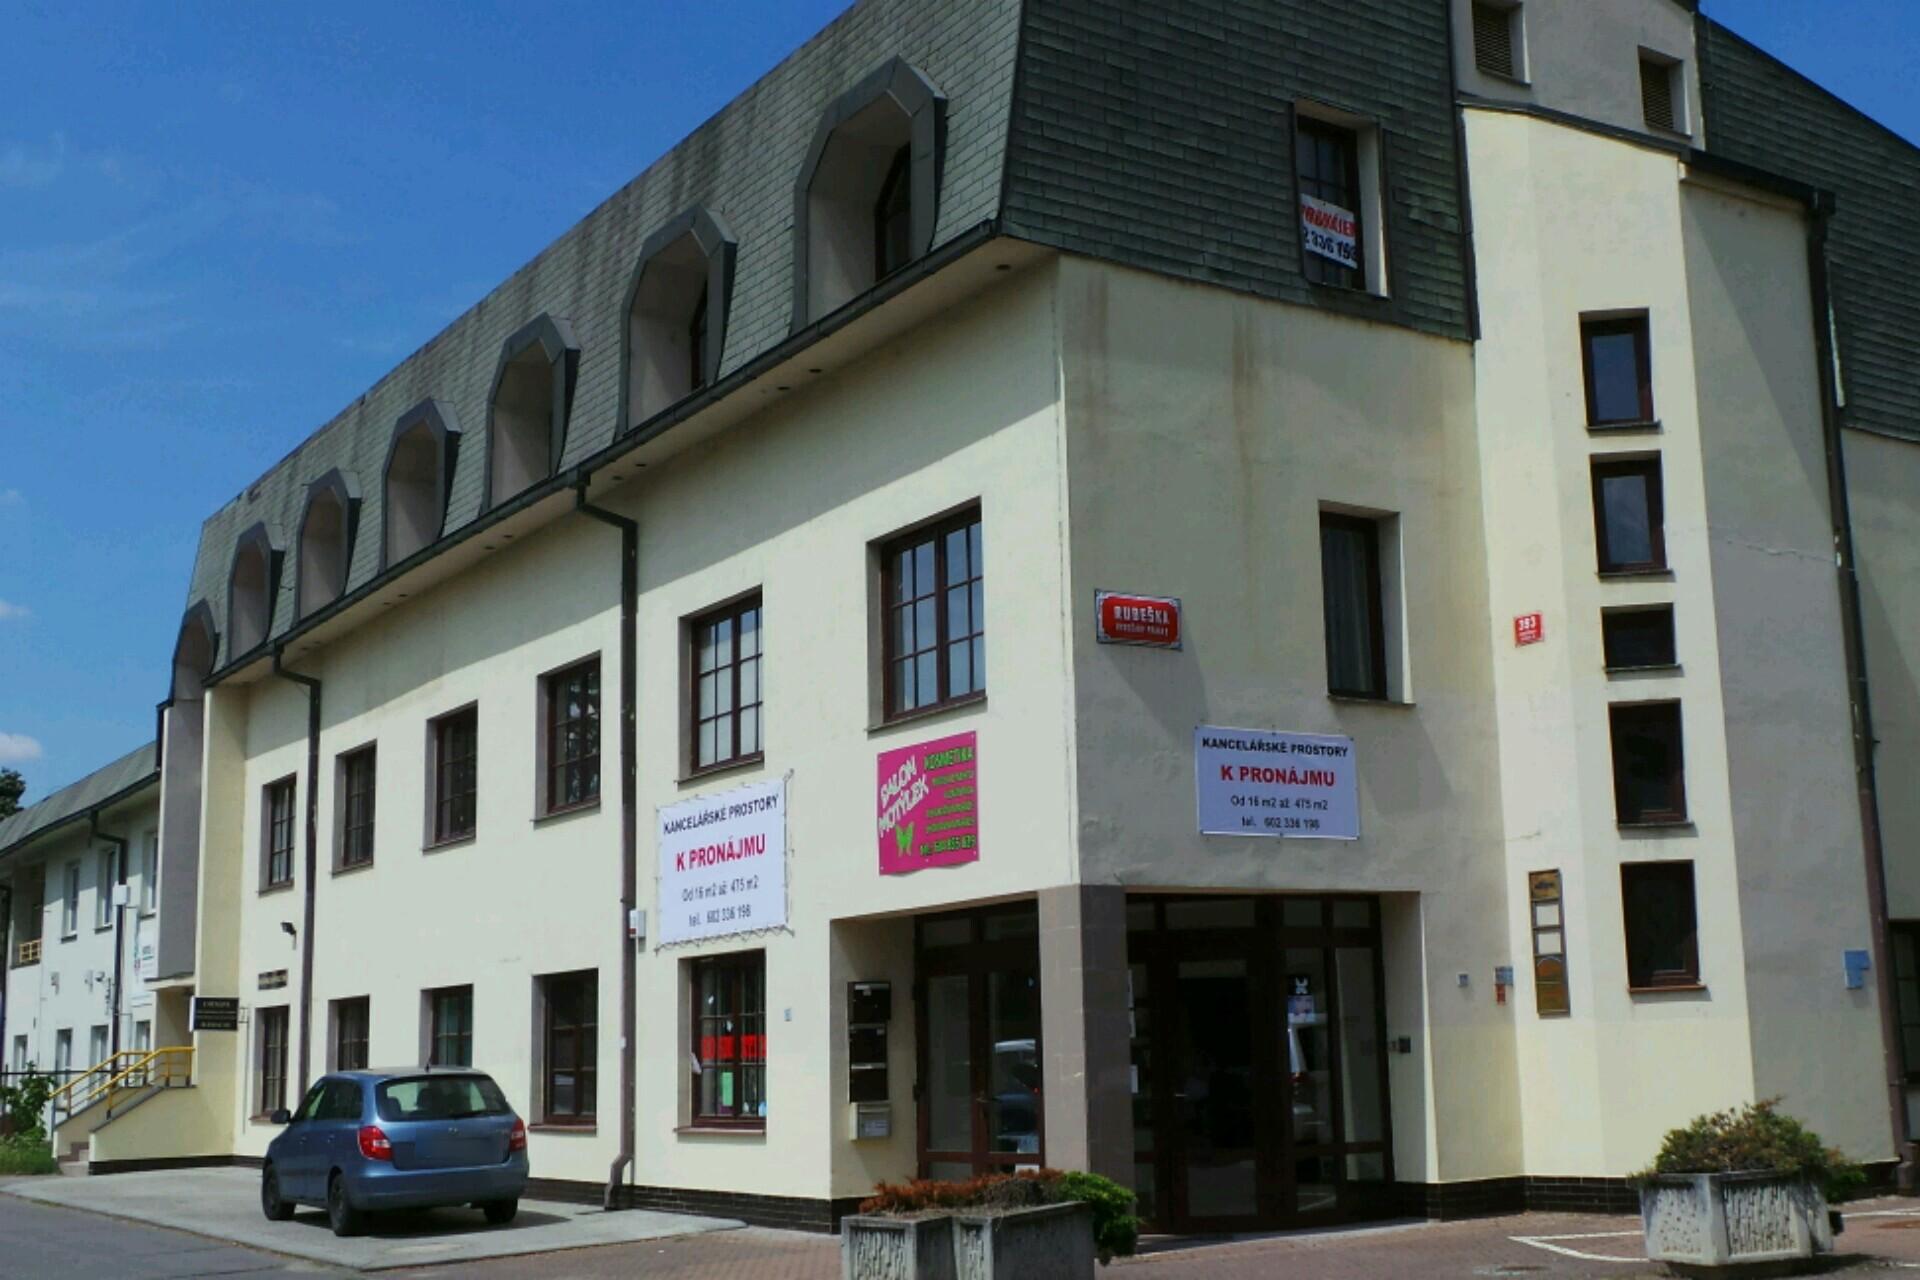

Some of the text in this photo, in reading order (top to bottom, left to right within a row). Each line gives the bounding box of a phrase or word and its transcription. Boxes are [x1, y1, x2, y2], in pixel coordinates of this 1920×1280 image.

[1202, 737, 1349, 758] KANCELÁŘSKÉ PROSTORY
[1220, 765, 1335, 787] K PRONÁJMU
[663, 793, 779, 835] KANCELÁŘSKÉ PROSTORY
[1231, 794, 1245, 807] Od
[1262, 797, 1277, 809] m2
[1295, 797, 1312, 810] 475
[1313, 799, 1329, 811] m2
[676, 832, 766, 873] K PRONÁJMU
[681, 886, 694, 902] Od
[705, 882, 717, 897] m2
[731, 877, 746, 893] 475
[747, 874, 759, 891] m2
